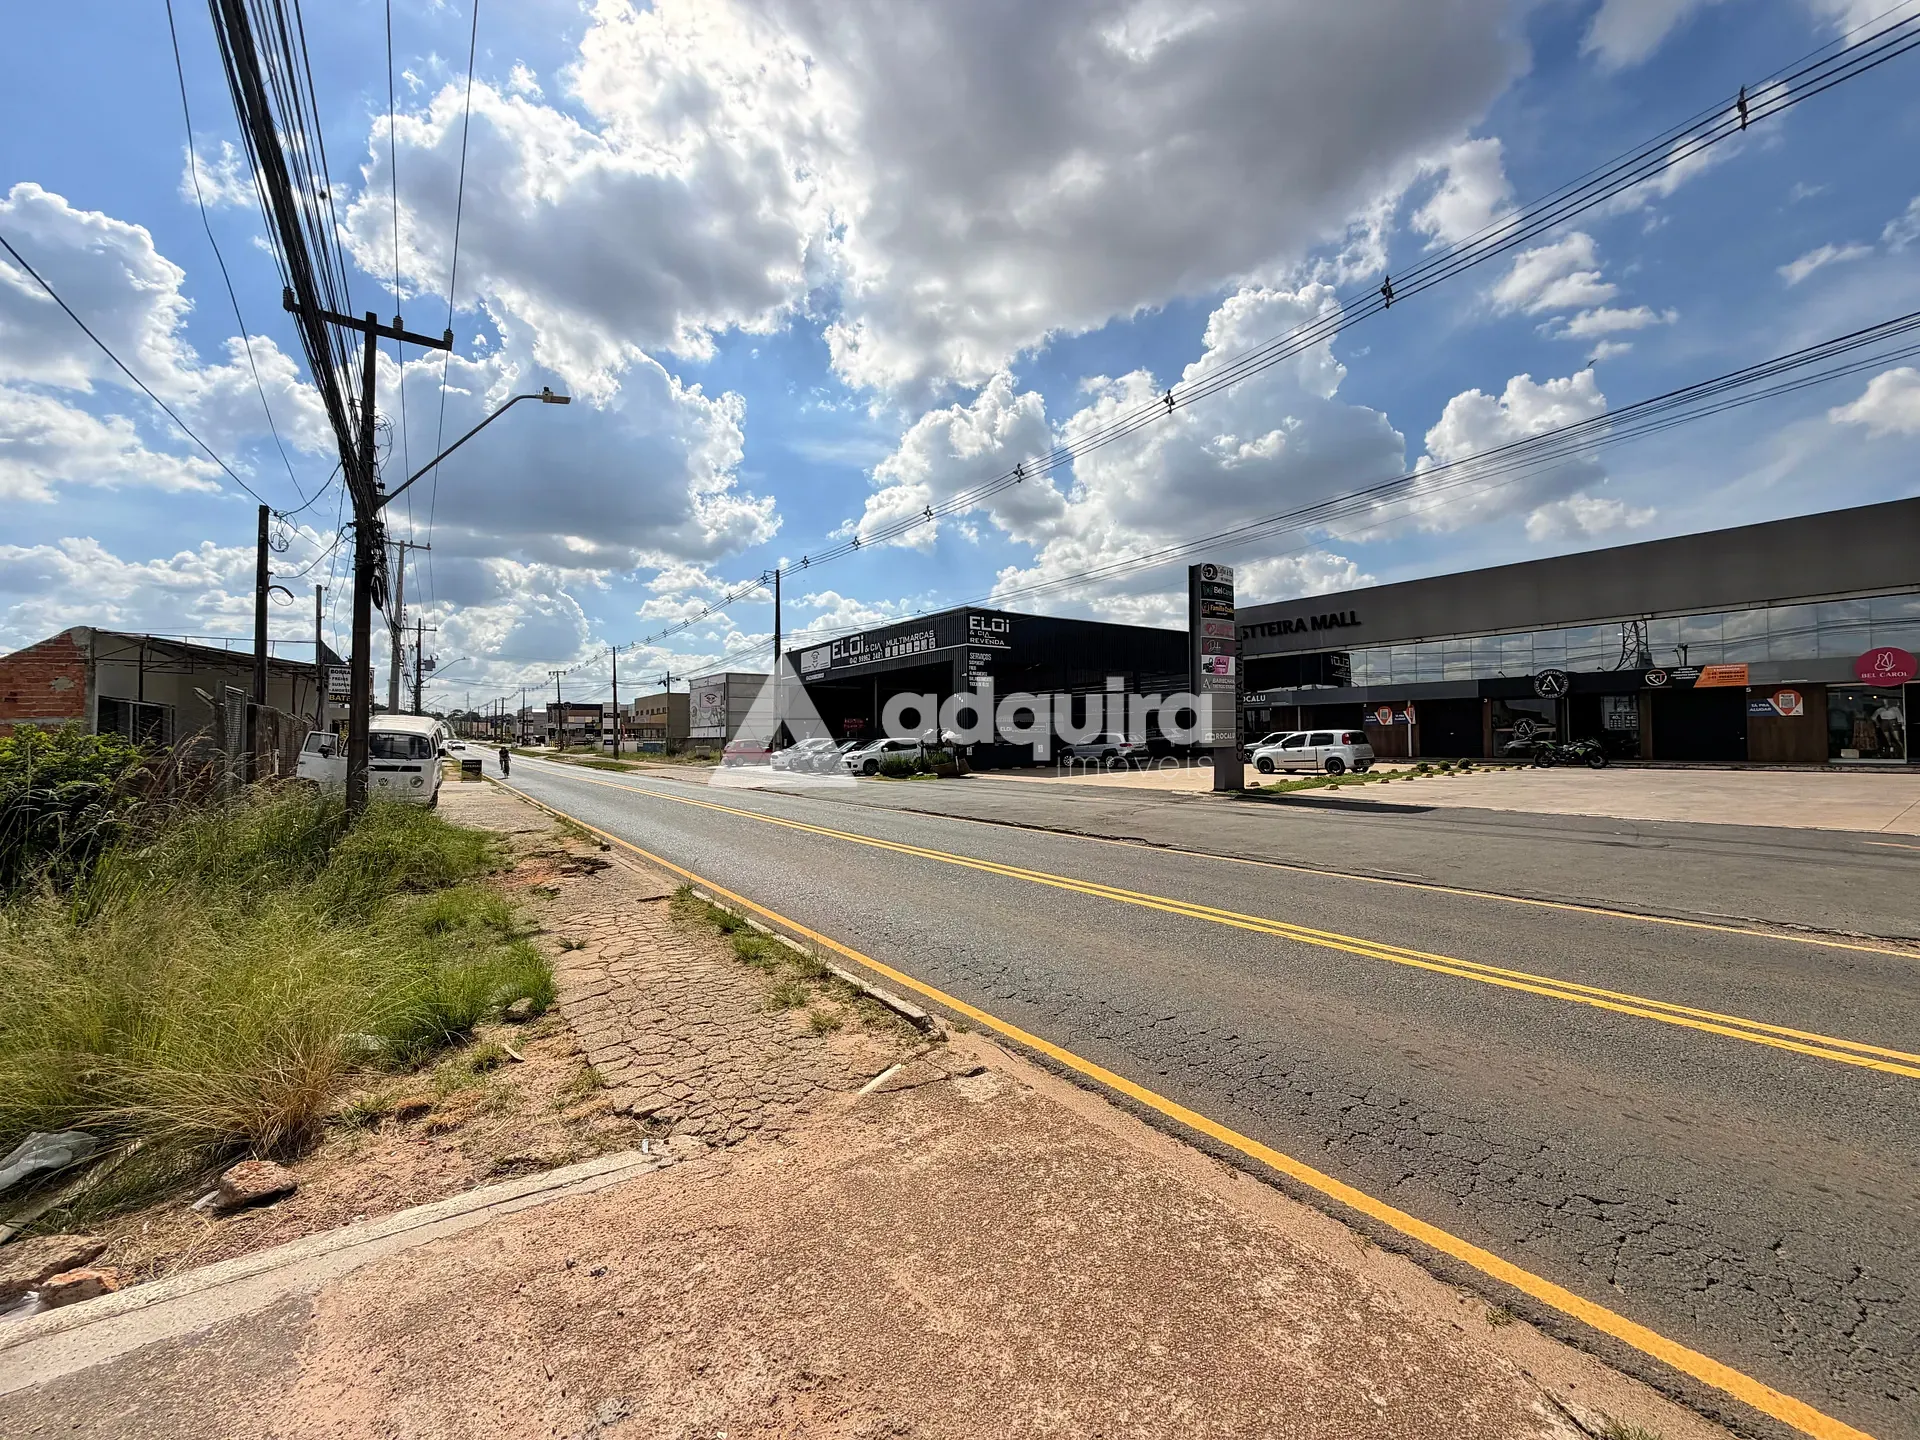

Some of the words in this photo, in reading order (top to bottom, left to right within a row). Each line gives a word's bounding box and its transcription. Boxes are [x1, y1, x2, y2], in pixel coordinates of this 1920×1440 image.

[1243, 618, 1307, 640] STTEIRA
[1310, 610, 1362, 630] MALL
[886, 630, 934, 646] MULTIMARCAS
